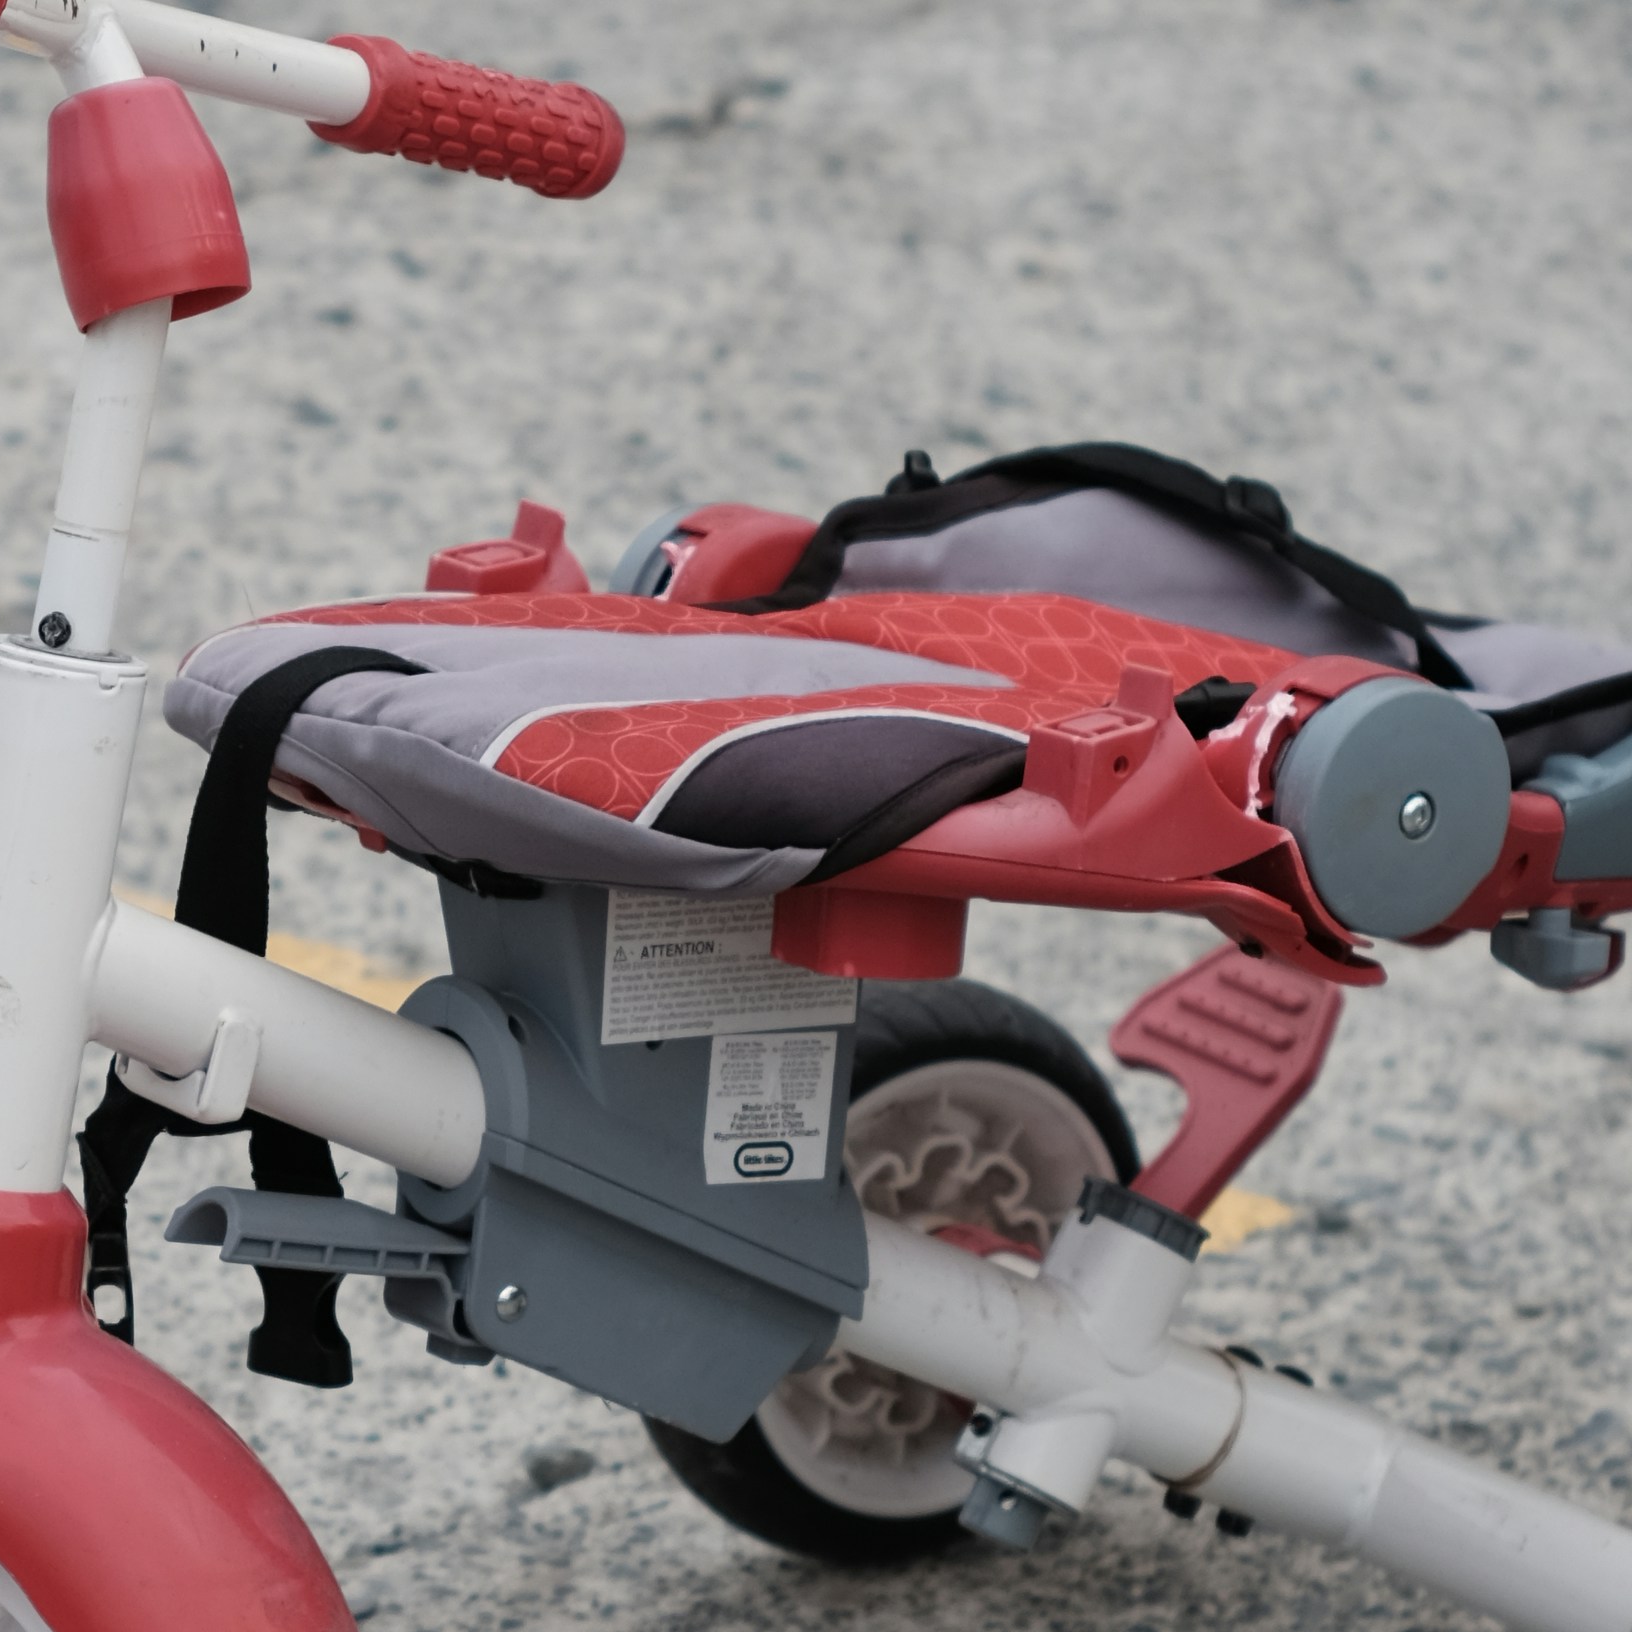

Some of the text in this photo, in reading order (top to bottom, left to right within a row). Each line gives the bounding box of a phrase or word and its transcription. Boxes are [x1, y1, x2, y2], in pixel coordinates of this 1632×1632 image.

[640, 941, 715, 959] ATTENTION
[741, 1103, 763, 1112] Made
[773, 1102, 797, 1112] China
[730, 1121, 769, 1131] Fabricado
[743, 1153, 784, 1165] little tikes
